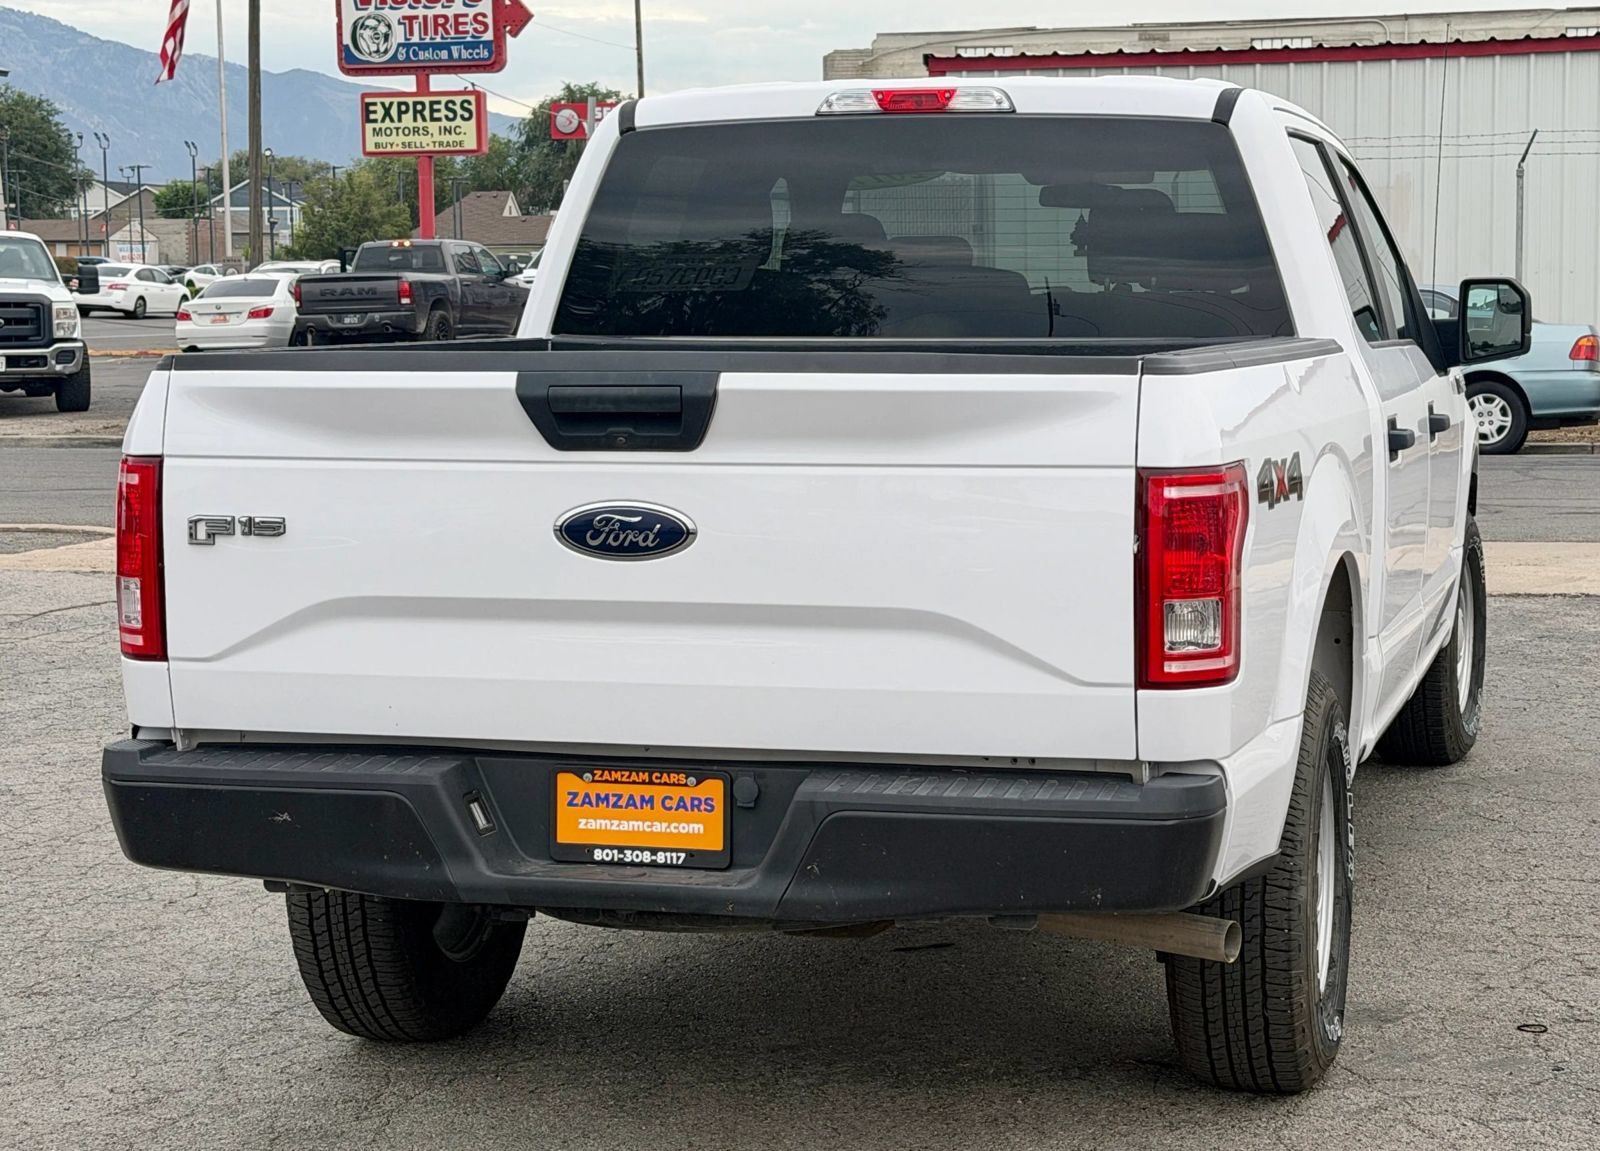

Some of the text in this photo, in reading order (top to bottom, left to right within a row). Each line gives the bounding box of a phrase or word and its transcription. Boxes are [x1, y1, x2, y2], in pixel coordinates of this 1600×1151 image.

[401, 12, 489, 38] TIRES
[409, 46, 449, 61] Custom
[450, 44, 489, 60] Wheels
[365, 99, 474, 124] EXPRESS
[372, 125, 467, 138] MOTORS, INC.
[320, 287, 378, 297] RAM
[585, 513, 662, 547] Ford
[593, 769, 687, 785] ZAMZAM CARS
[566, 791, 716, 814] ZAMZAM CARS
[578, 818, 705, 834] zamzamcar.com
[593, 848, 686, 865] 801-308-8117
